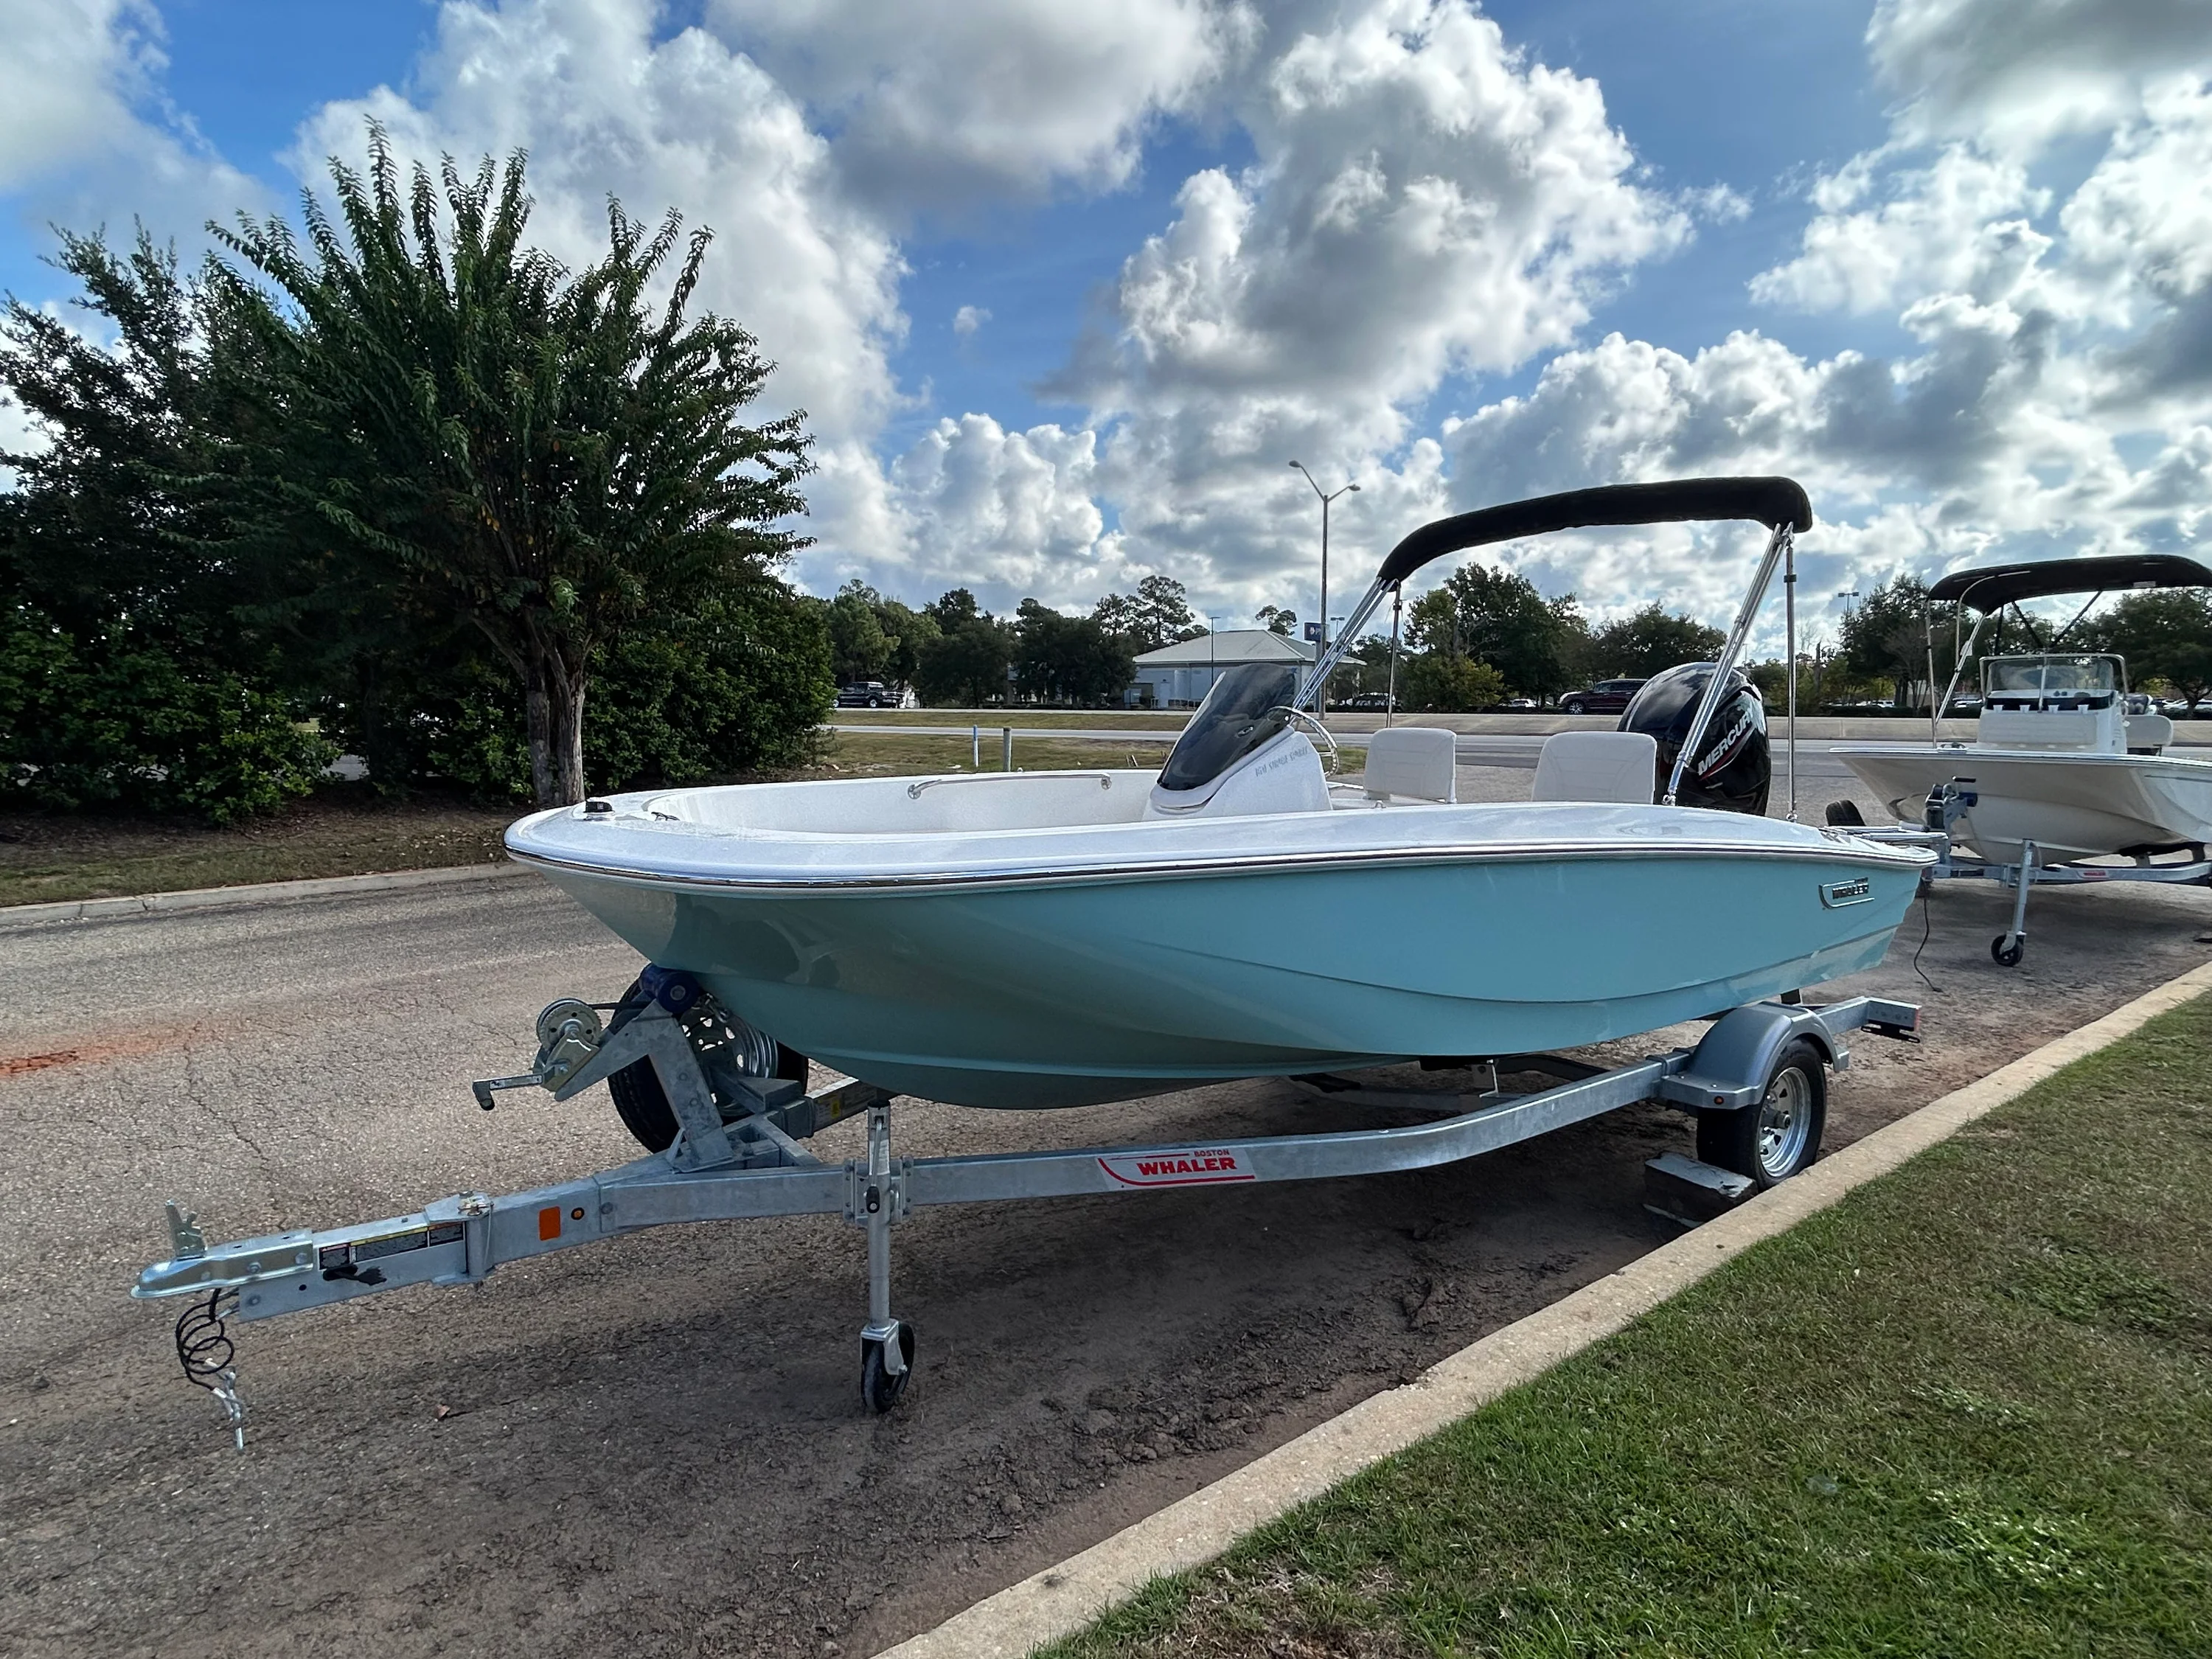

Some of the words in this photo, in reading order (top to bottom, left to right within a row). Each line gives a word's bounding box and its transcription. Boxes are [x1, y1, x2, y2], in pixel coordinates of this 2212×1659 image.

[1697, 708, 1753, 776] MERCUR
[1194, 1149, 1230, 1158] BOSTON
[1136, 1157, 1237, 1175] WHALER
